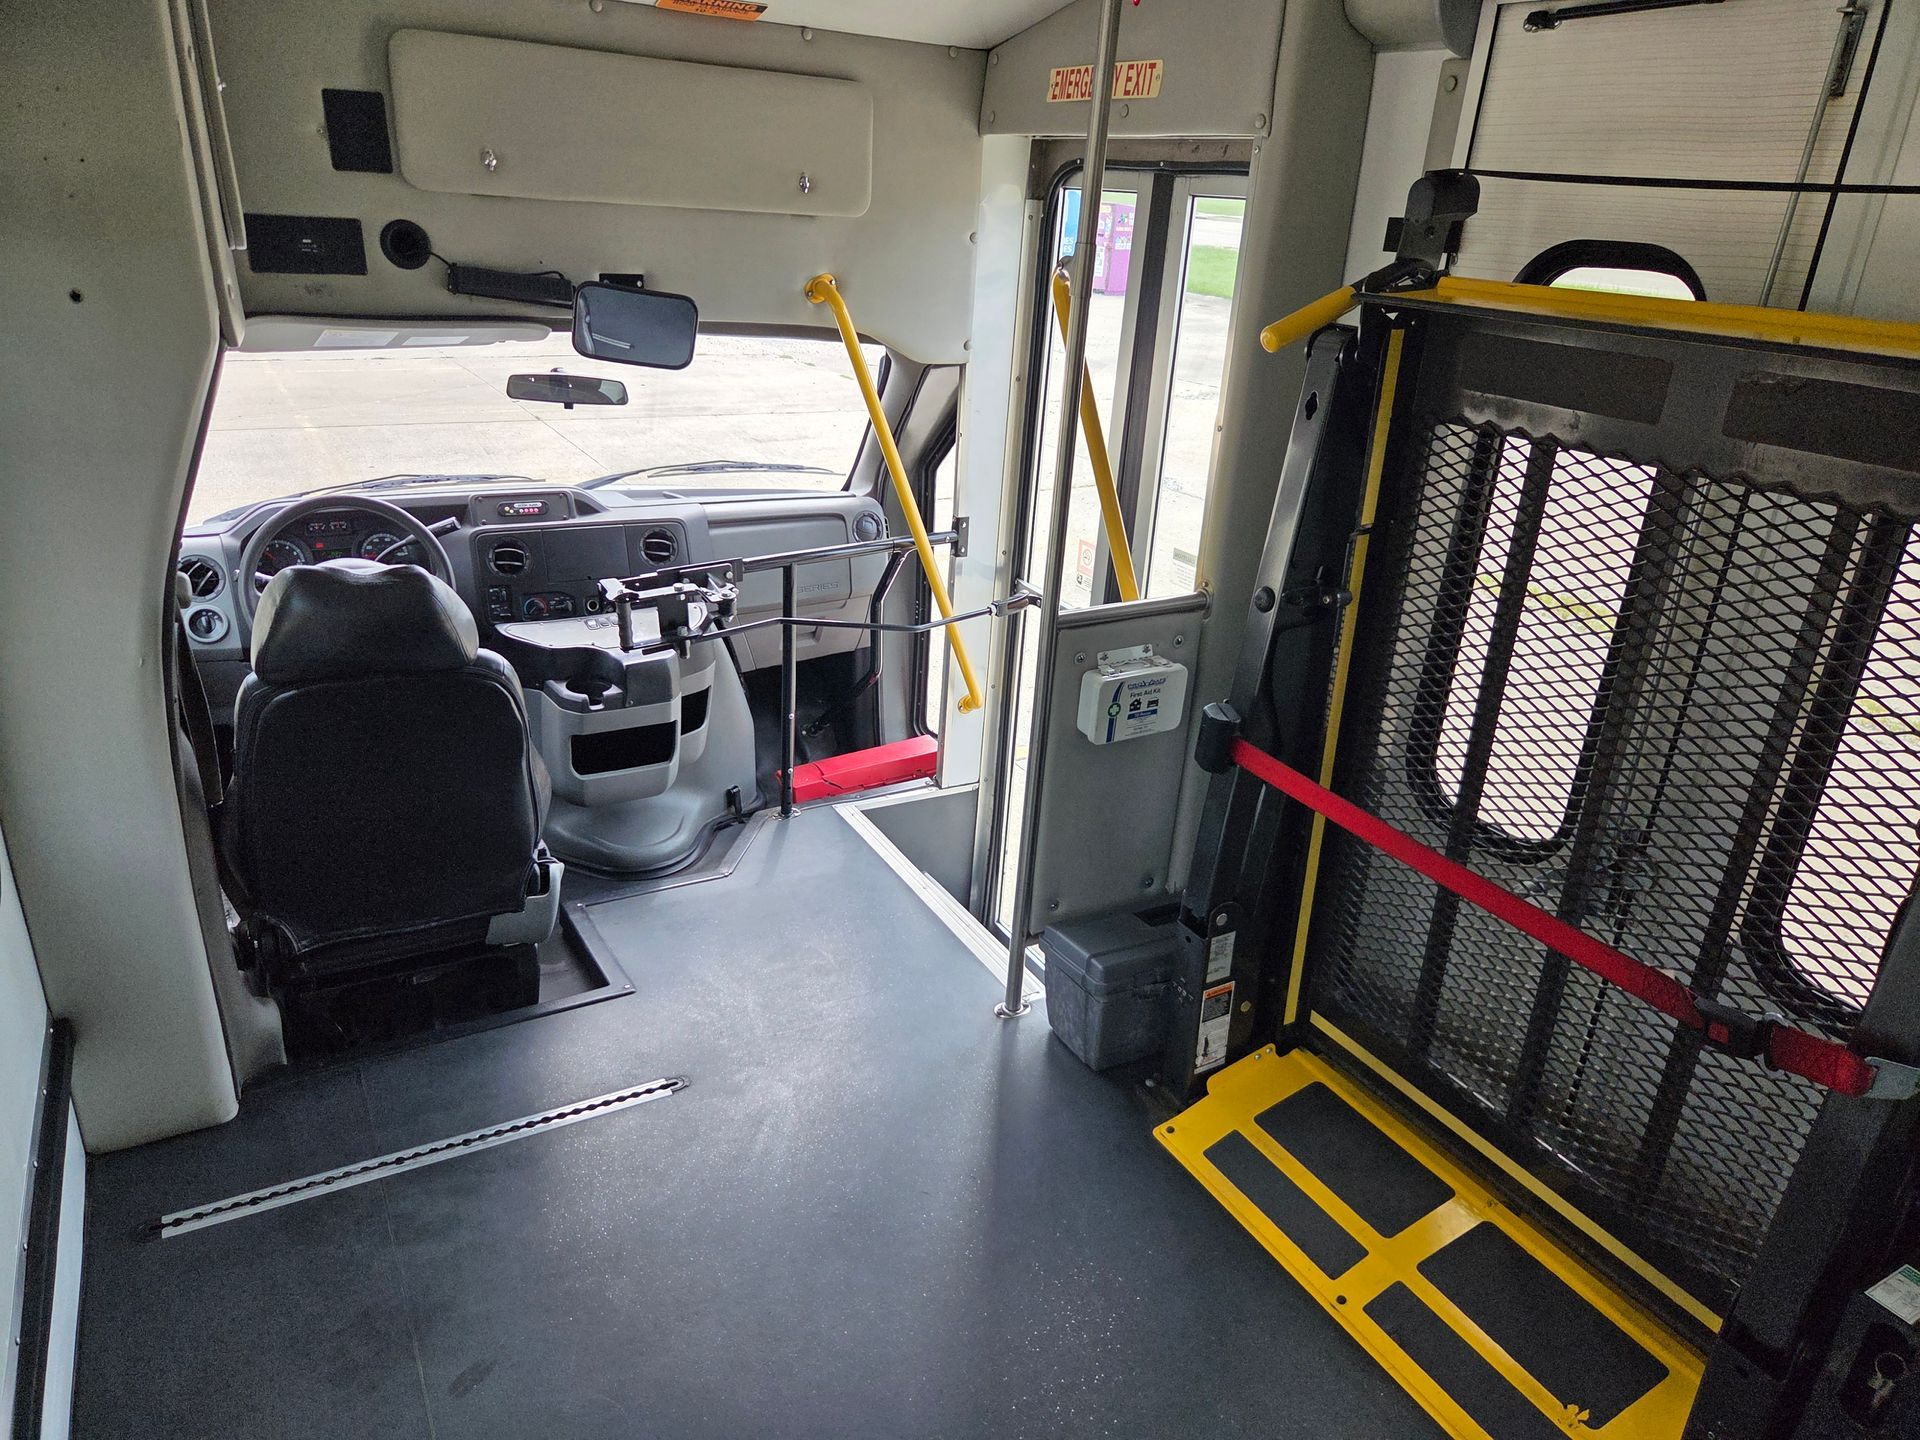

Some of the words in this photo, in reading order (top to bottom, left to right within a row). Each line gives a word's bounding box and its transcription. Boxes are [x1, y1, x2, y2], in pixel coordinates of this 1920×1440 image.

[1051, 64, 1123, 100] EMERGEY
[1123, 62, 1157, 96] EXIT
[1153, 687, 1161, 695] Kit
